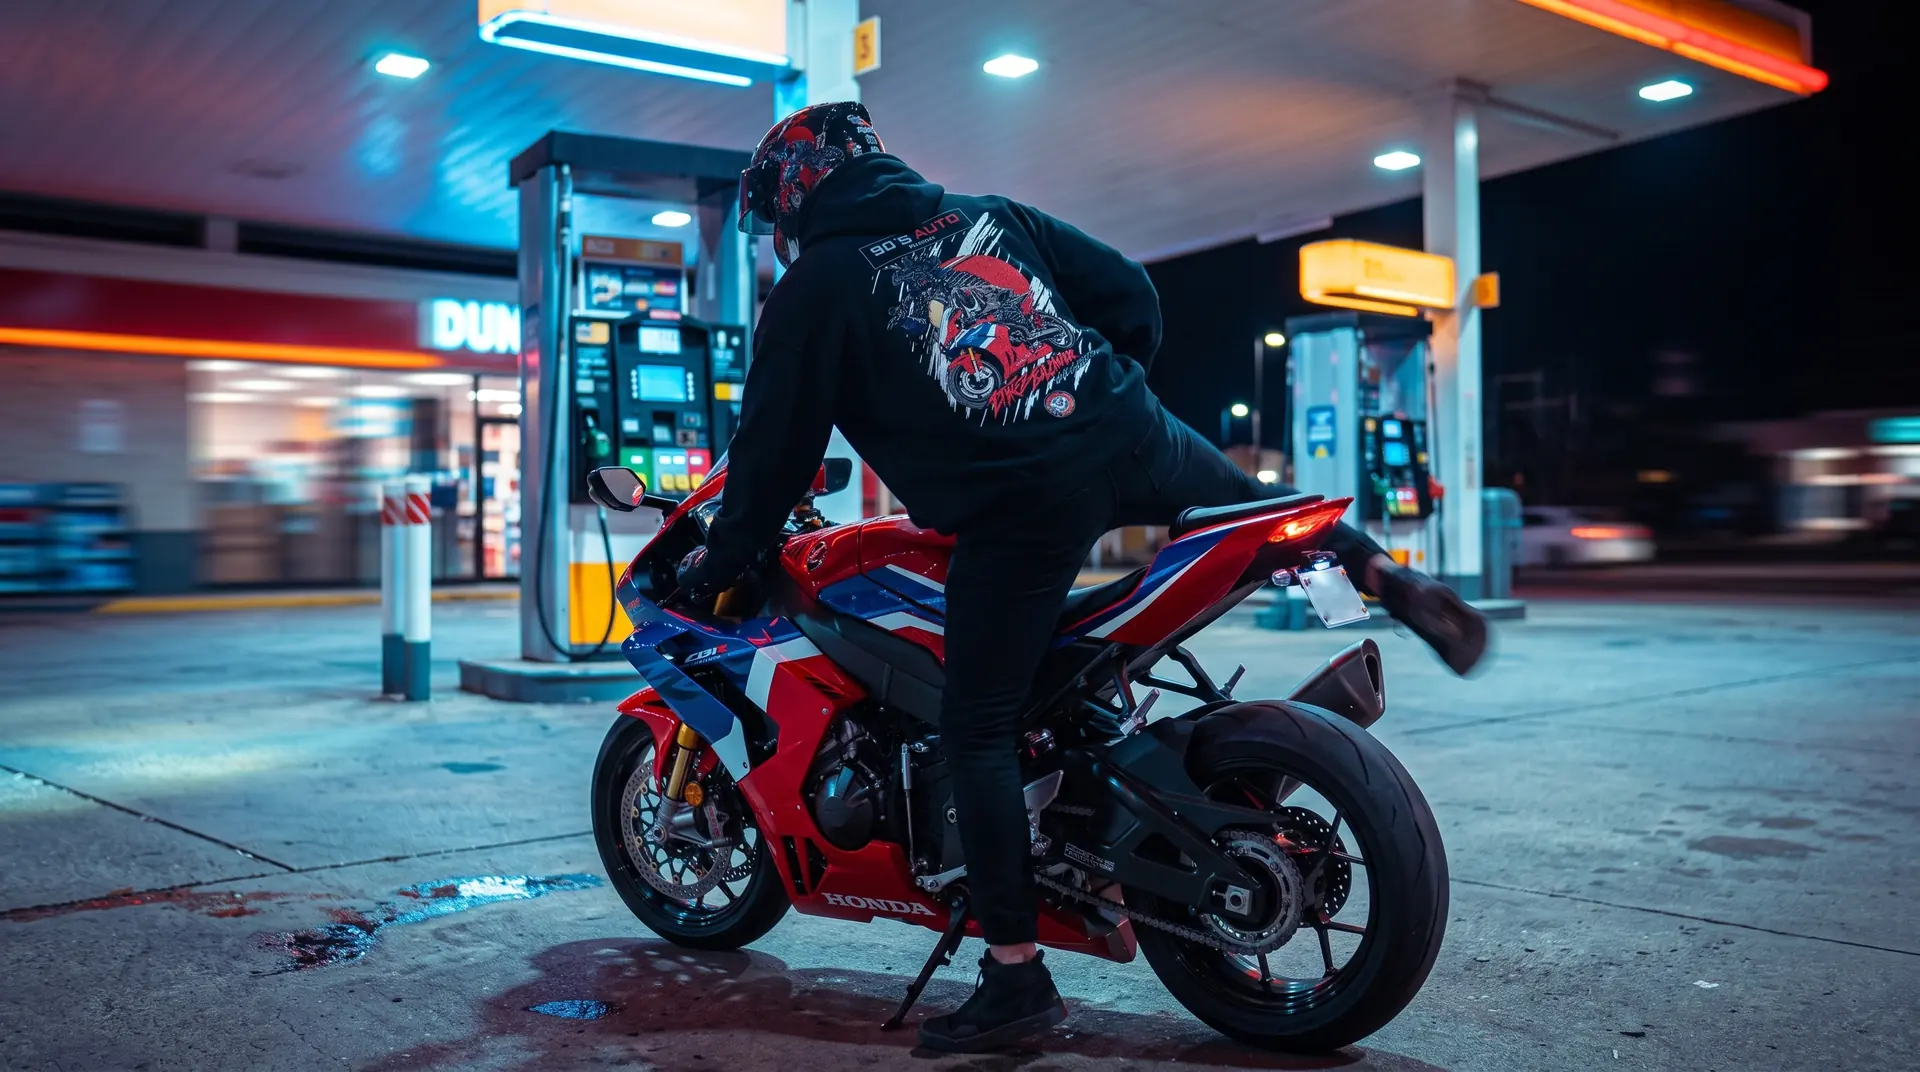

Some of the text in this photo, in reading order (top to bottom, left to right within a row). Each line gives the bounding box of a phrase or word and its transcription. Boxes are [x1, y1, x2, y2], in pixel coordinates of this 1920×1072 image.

[870, 234, 913, 257] 90'S
[914, 213, 960, 240] AUTO
[433, 297, 521, 356] DUN
[821, 892, 937, 916] HONDA
